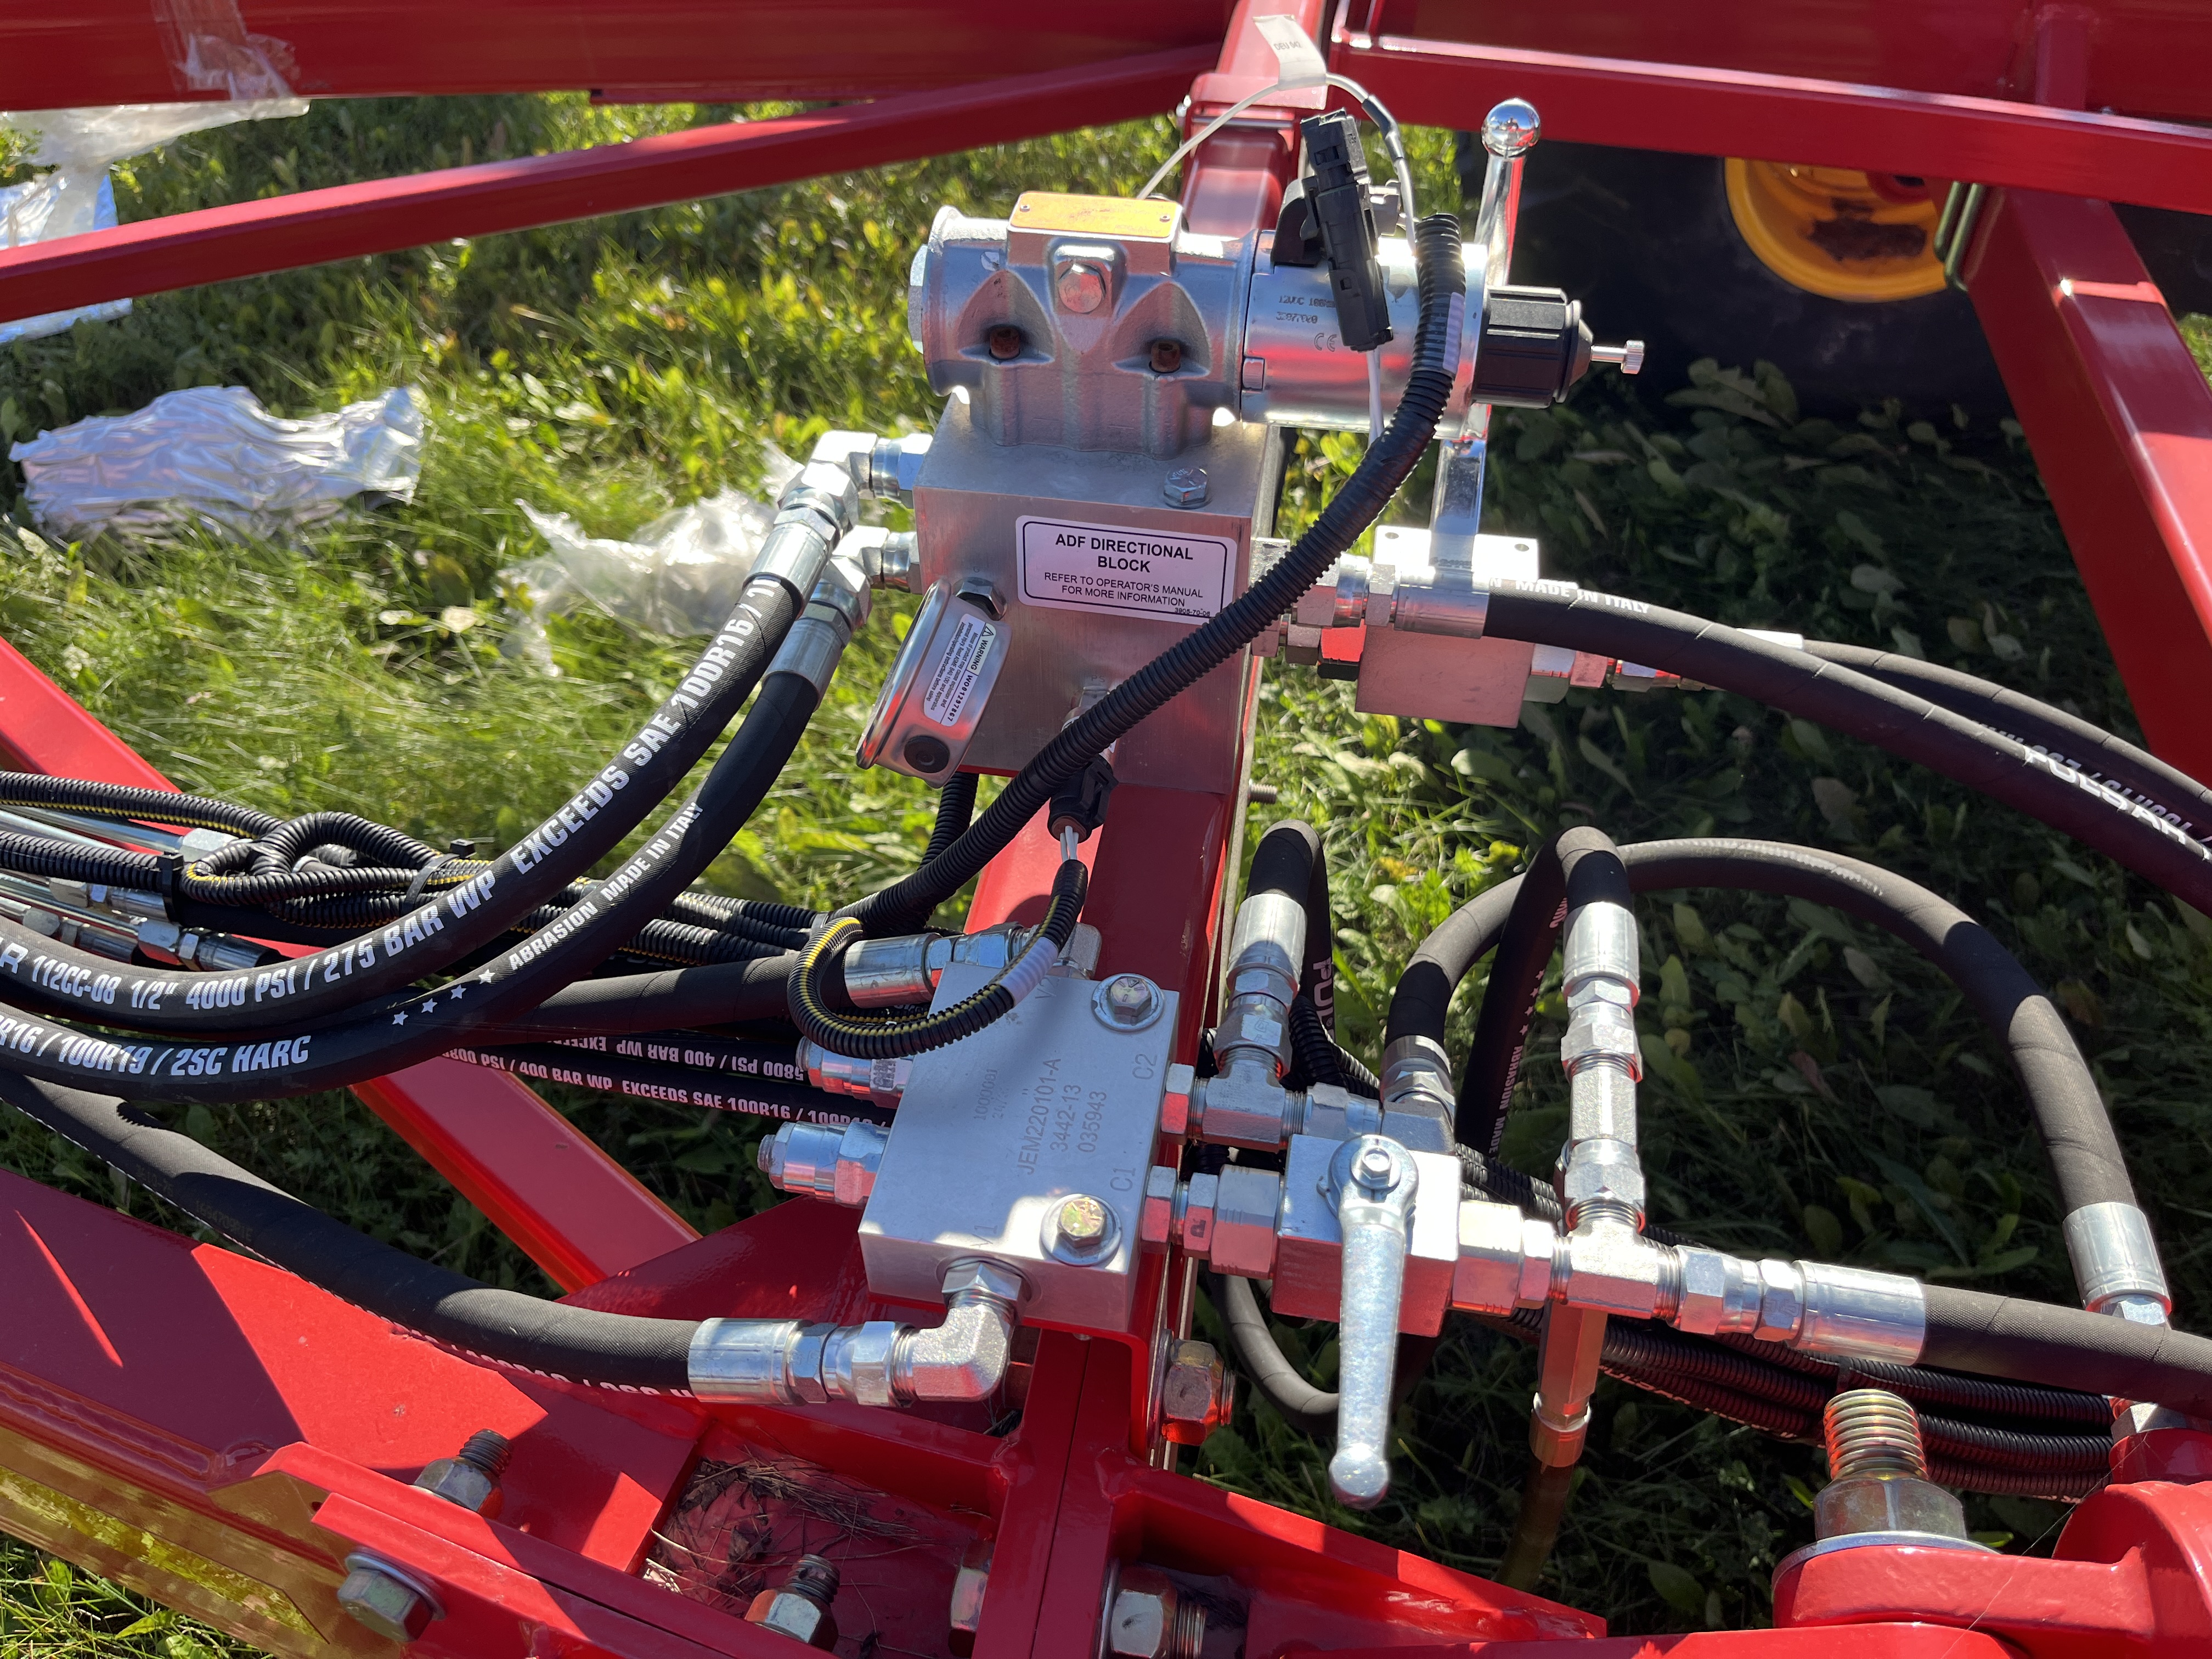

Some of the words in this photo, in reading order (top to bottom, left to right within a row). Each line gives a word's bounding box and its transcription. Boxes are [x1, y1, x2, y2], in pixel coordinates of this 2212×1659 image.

[1055, 533, 1086, 548] ADF
[1091, 538, 1193, 560] DIRECTIONAL
[1098, 556, 1151, 573] BLOCK
[1044, 572, 1077, 584] REFER
[1080, 575, 1093, 585] TO
[1096, 578, 1160, 593] OPERATOR'S
[1163, 585, 1203, 598] MANUAL
[1062, 585, 1082, 596] FOR
[1085, 588, 1114, 599] MORE
[1117, 591, 1185, 607] INFORMATION
[1515, 580, 1570, 597] MADE
[1576, 589, 1599, 603] IN
[1605, 593, 1650, 614] ITALY
[970, 640, 989, 671] WARNING
[186, 976, 249, 1011] 4000
[255, 965, 297, 1003] PSI
[304, 958, 319, 990] /
[323, 938, 376, 983] 275
[383, 905, 445, 957] BAR
[447, 870, 496, 919] WP
[510, 764, 630, 875] EXCEEDS
[624, 713, 681, 766] SAE
[670, 619, 754, 709] 100R16
[508, 901, 599, 971] ABRASION
[600, 857, 652, 902] MADE
[646, 838, 671, 860] IN
[665, 802, 704, 840] ITALY
[0, 1014, 44, 1053] R16
[59, 1035, 154, 1074] 100R19
[171, 1047, 228, 1076] 2SC
[232, 1035, 312, 1074] HARC
[616, 1040, 644, 1057] WP
[648, 1043, 679, 1062] BAR
[684, 1049, 715, 1068] 400
[732, 1056, 758, 1075] PSI
[1132, 1053, 1159, 1080] C2
[1499, 1045, 1523, 1110] ABRASION
[481, 1053, 506, 1071] PSI
[519, 1061, 549, 1079] 400
[552, 1068, 584, 1086] BAR
[586, 1074, 613, 1091] WP
[622, 1080, 689, 1104] EXCEEDS
[692, 1091, 724, 1109] SAE
[727, 1097, 791, 1120] 100R16
[1017, 1057, 1062, 1175] JEM220101-A
[1049, 1083, 1082, 1153] 3442-13
[1077, 1090, 1107, 1153] 035943
[1488, 1115, 1506, 1154] MADE
[1110, 1167, 1136, 1192] C1
